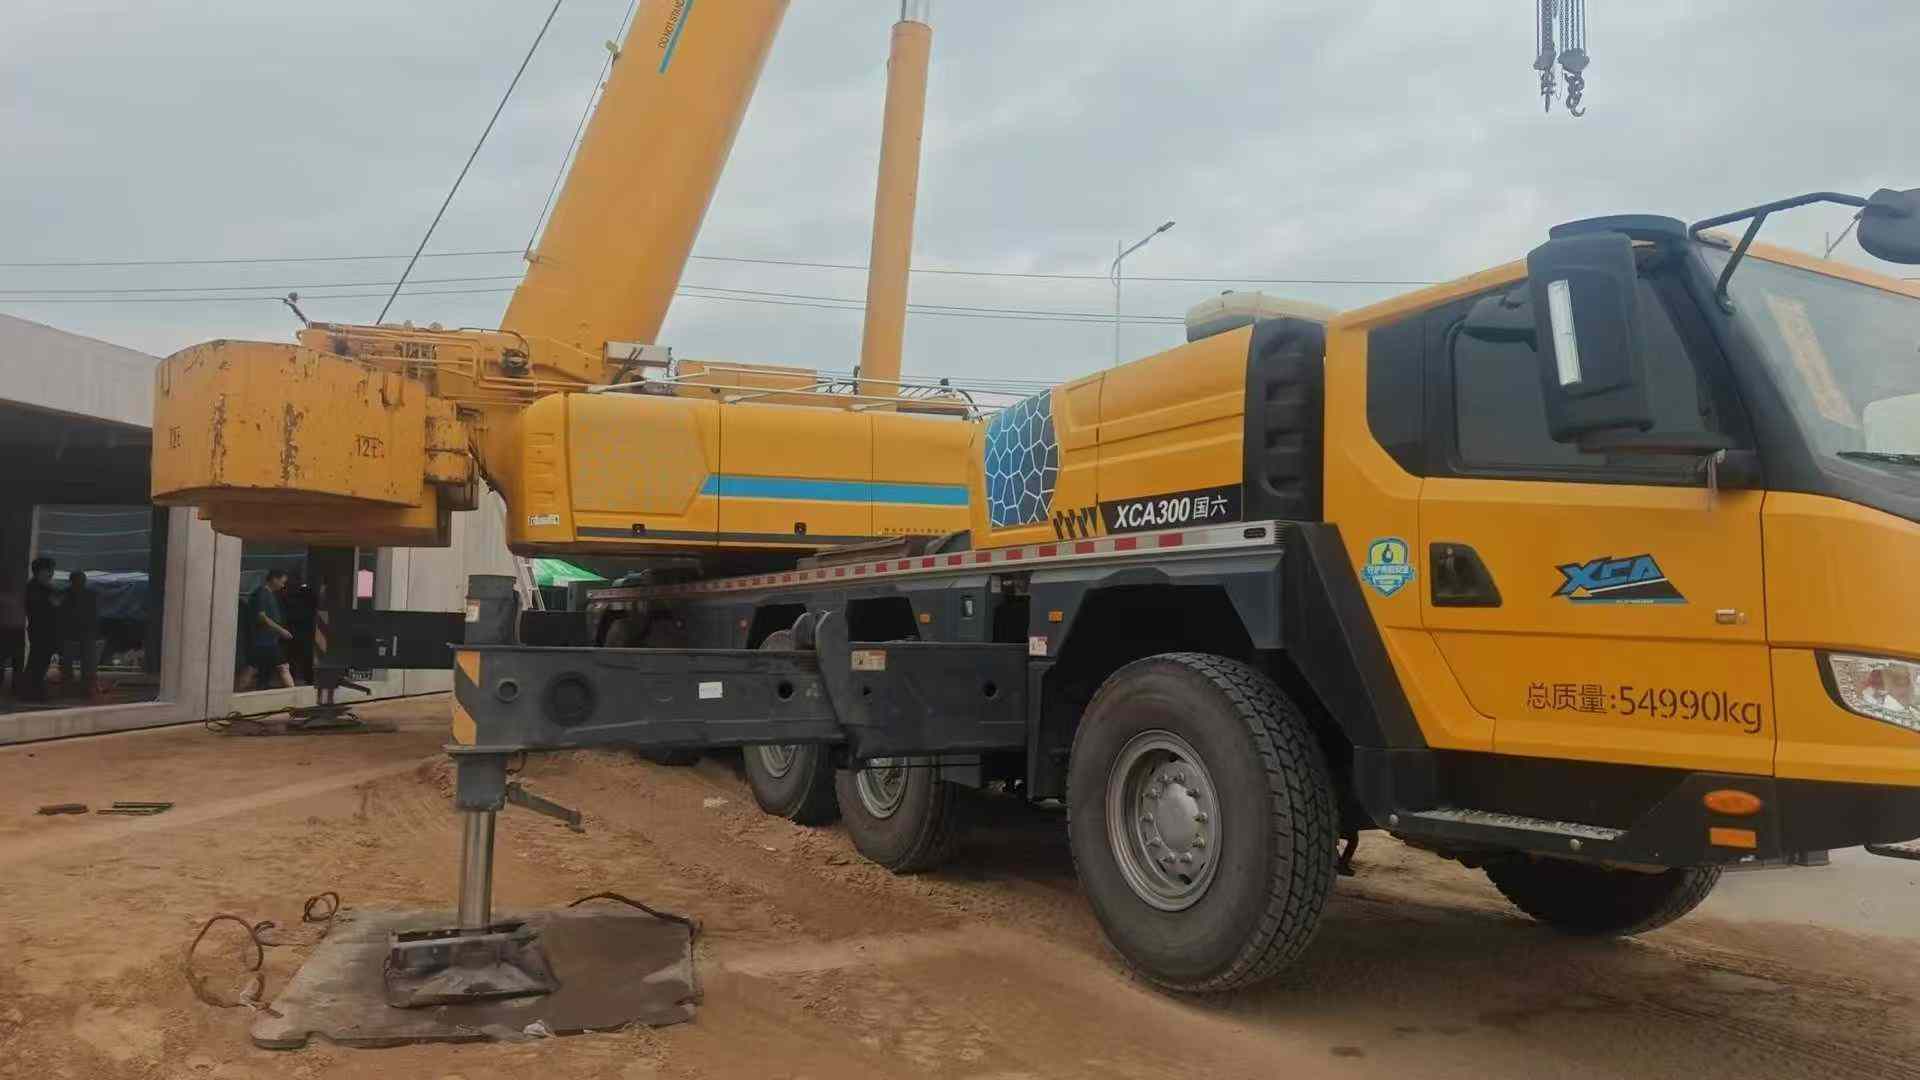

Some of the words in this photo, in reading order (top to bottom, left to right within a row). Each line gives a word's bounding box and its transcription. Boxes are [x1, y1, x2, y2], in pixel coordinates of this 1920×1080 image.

[1113, 497, 1191, 529] XCA300
[1193, 495, 1228, 520] 国六
[1553, 555, 1664, 596] XCA
